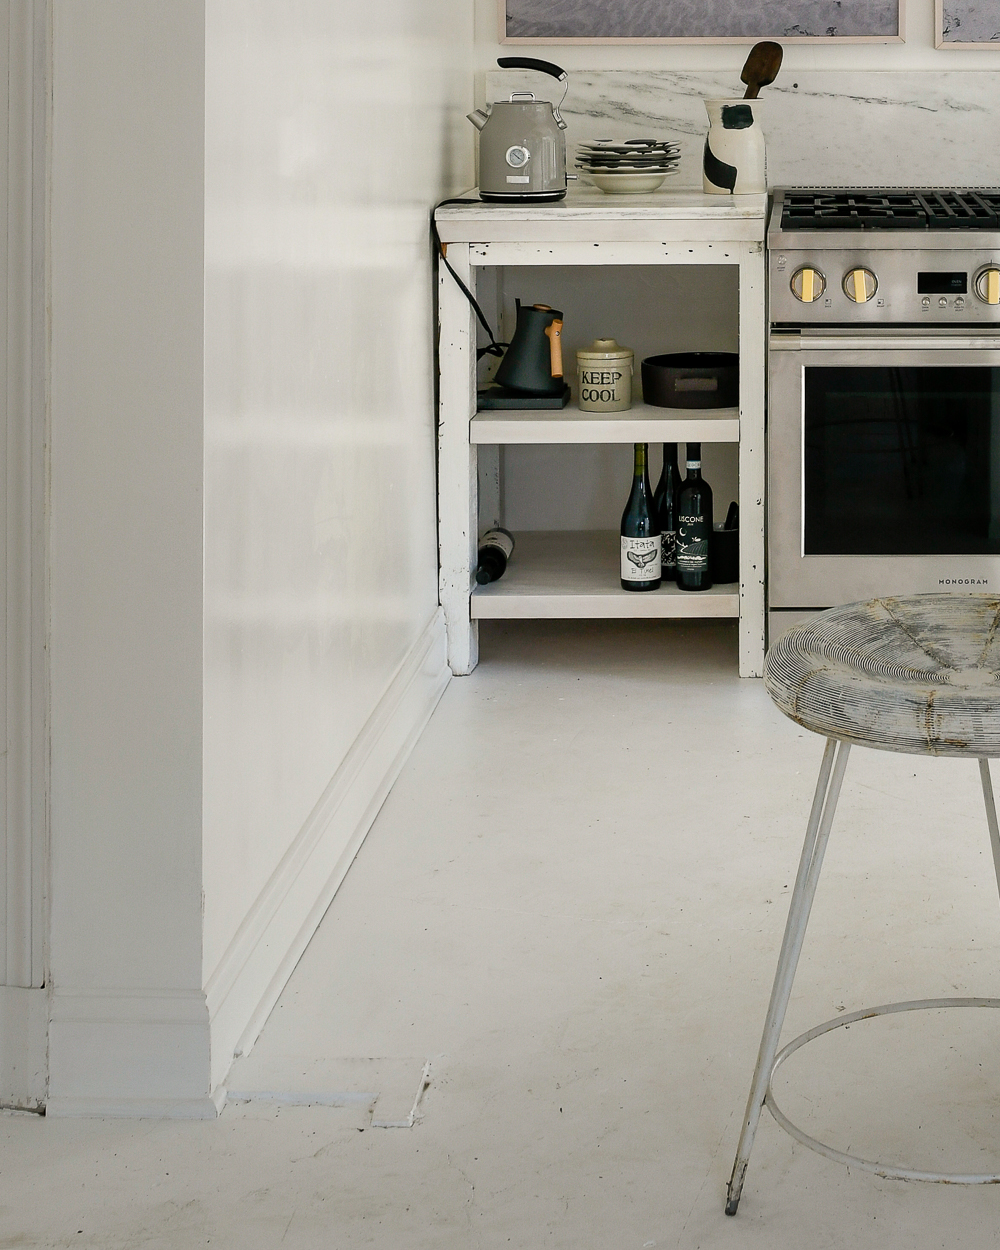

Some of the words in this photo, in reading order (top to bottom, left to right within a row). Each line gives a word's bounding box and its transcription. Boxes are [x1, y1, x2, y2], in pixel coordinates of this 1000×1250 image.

[582, 370, 623, 385] KEEP
[582, 388, 621, 402] COOL
[630, 540, 655, 549] Itata
